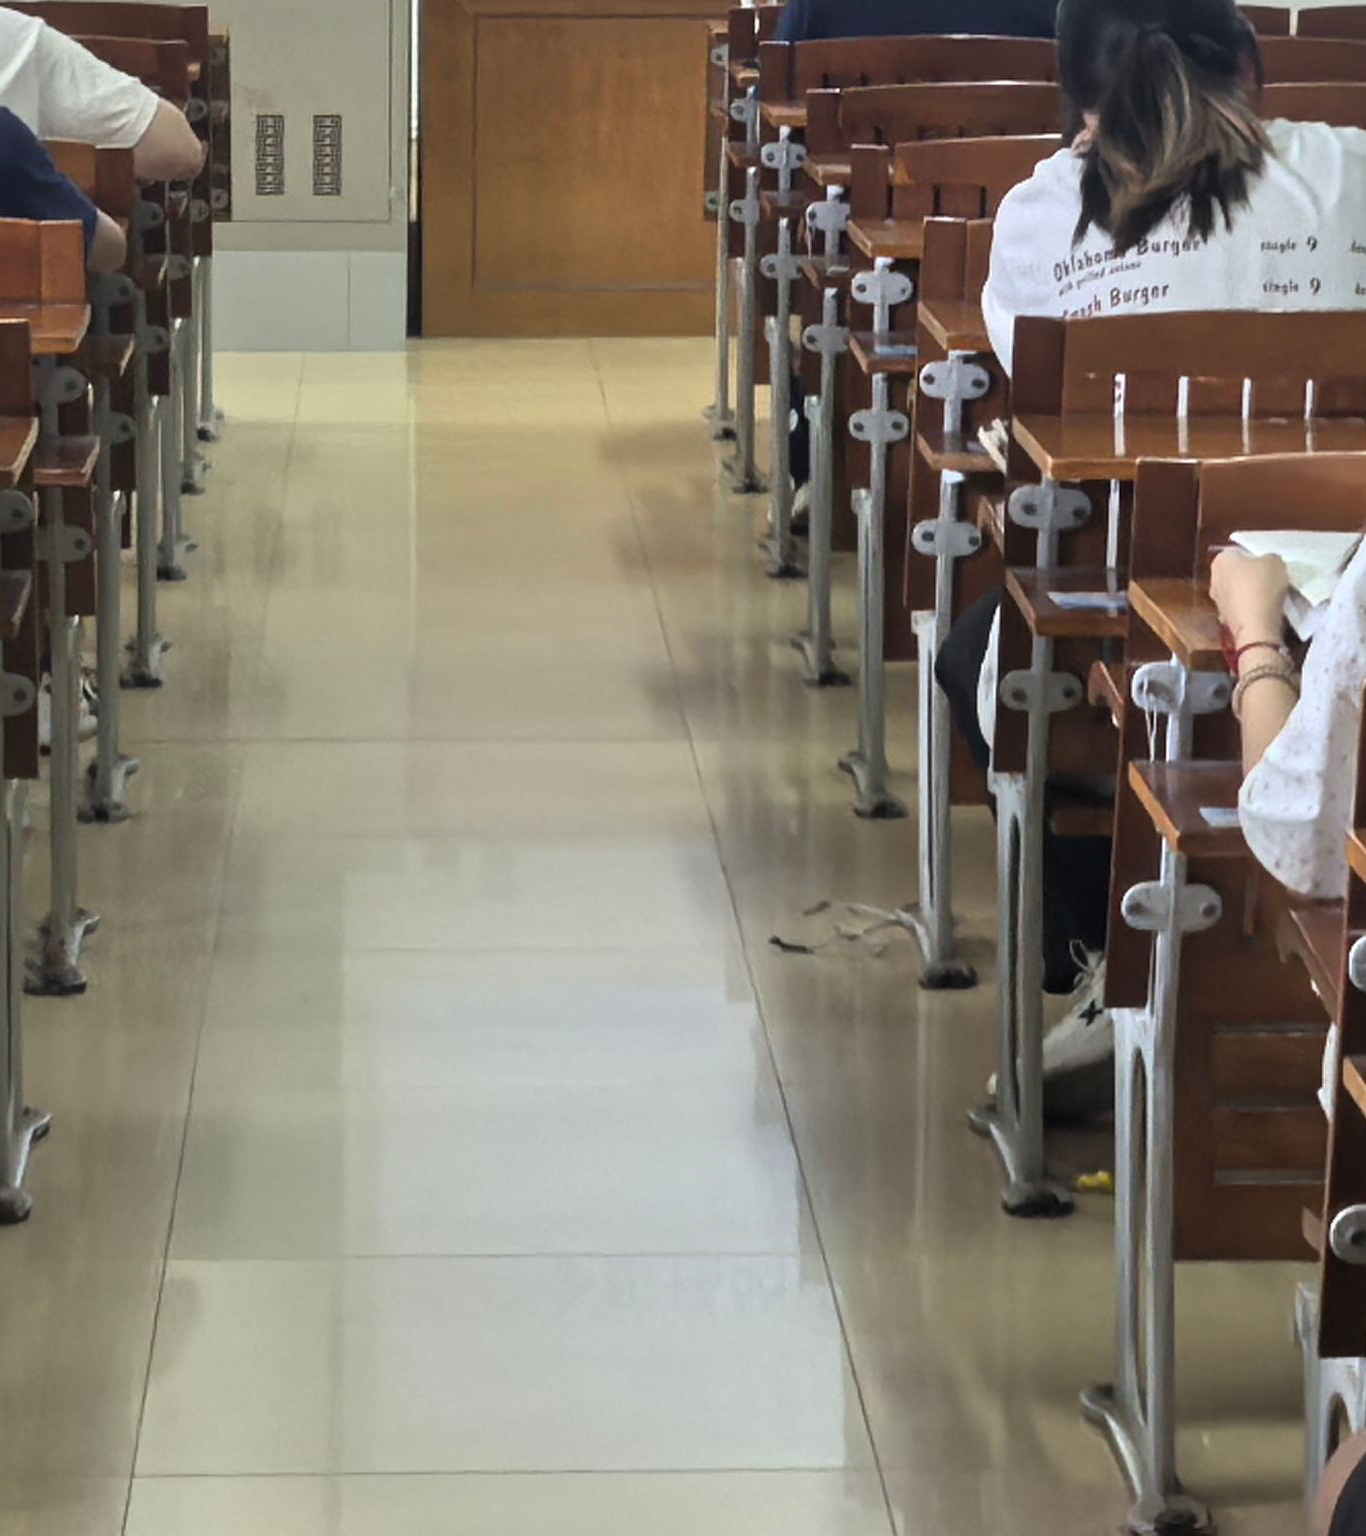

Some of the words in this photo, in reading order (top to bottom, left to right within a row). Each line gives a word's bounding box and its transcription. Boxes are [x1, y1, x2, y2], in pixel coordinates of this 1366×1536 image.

[1053, 248, 1125, 283] Oklahom
[1136, 237, 1200, 258] Burger
[1307, 236, 1318, 252] 9
[1110, 283, 1170, 308] Burger
[1310, 277, 1321, 295] 9
